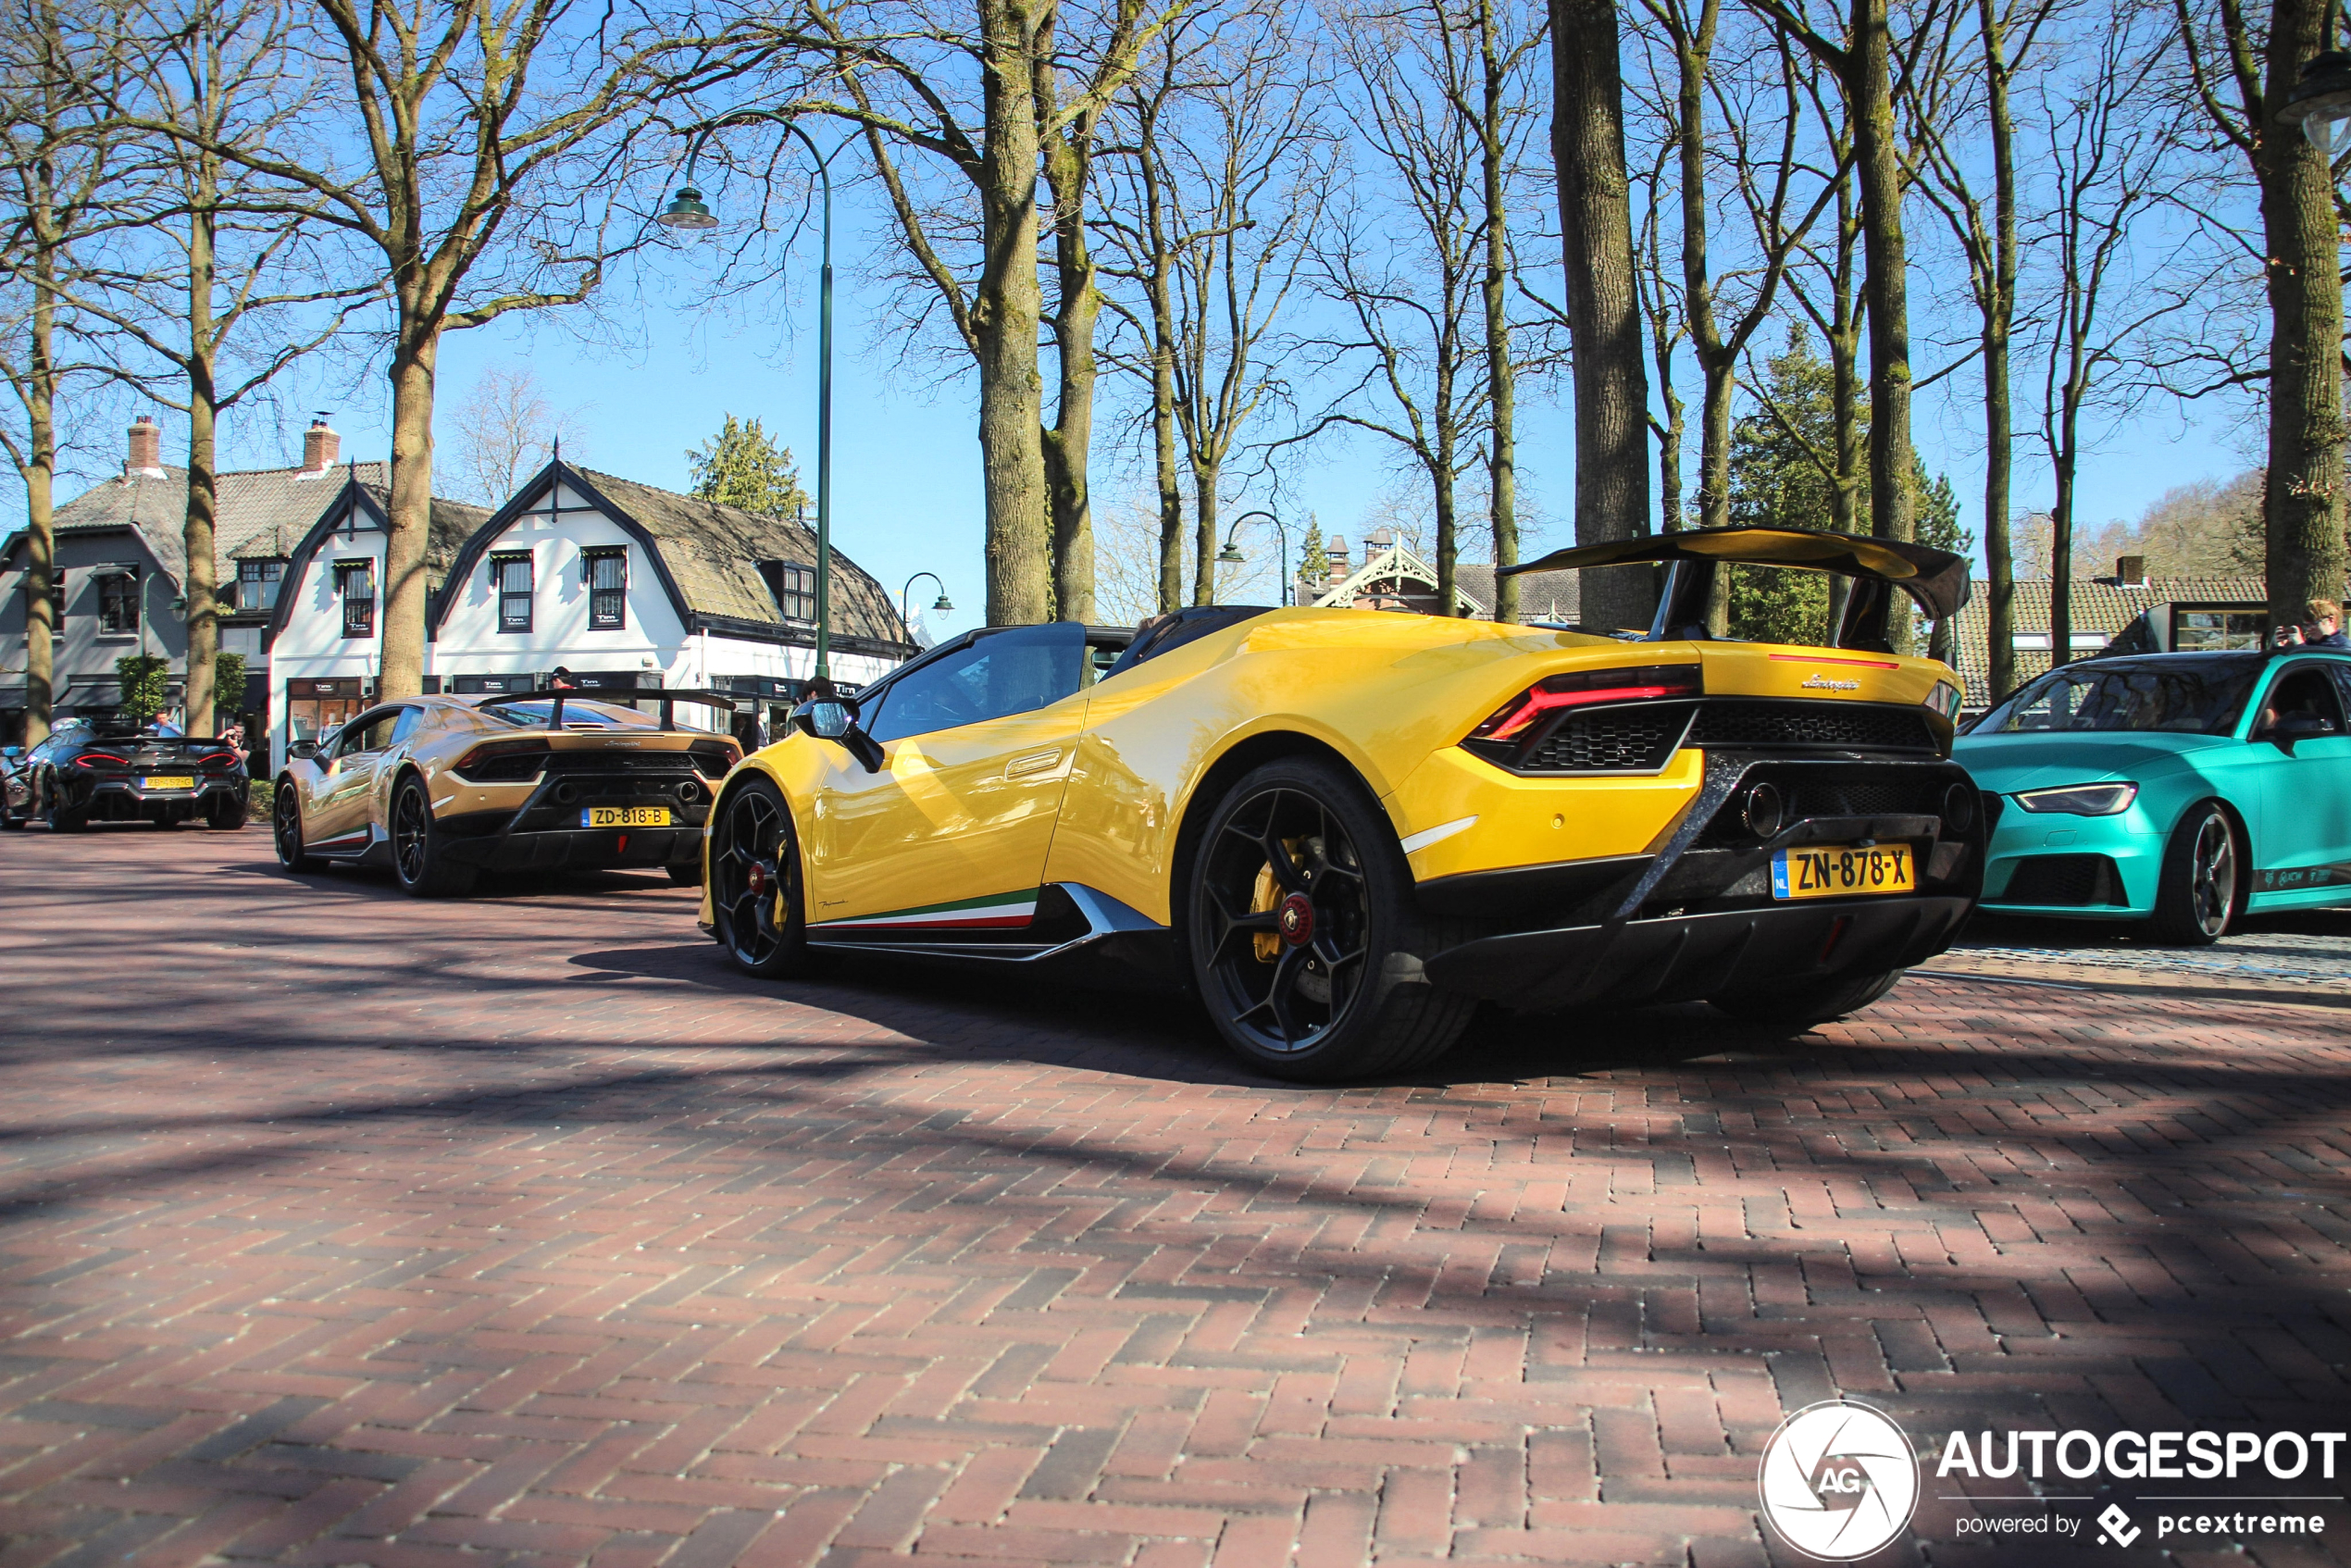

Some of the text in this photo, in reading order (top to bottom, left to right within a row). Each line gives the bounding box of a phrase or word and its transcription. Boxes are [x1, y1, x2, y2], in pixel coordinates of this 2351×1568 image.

[834, 683, 855, 694] Tim
[595, 809, 662, 824] ZD-818-B
[1775, 850, 1907, 890] NL ZN-878-X
